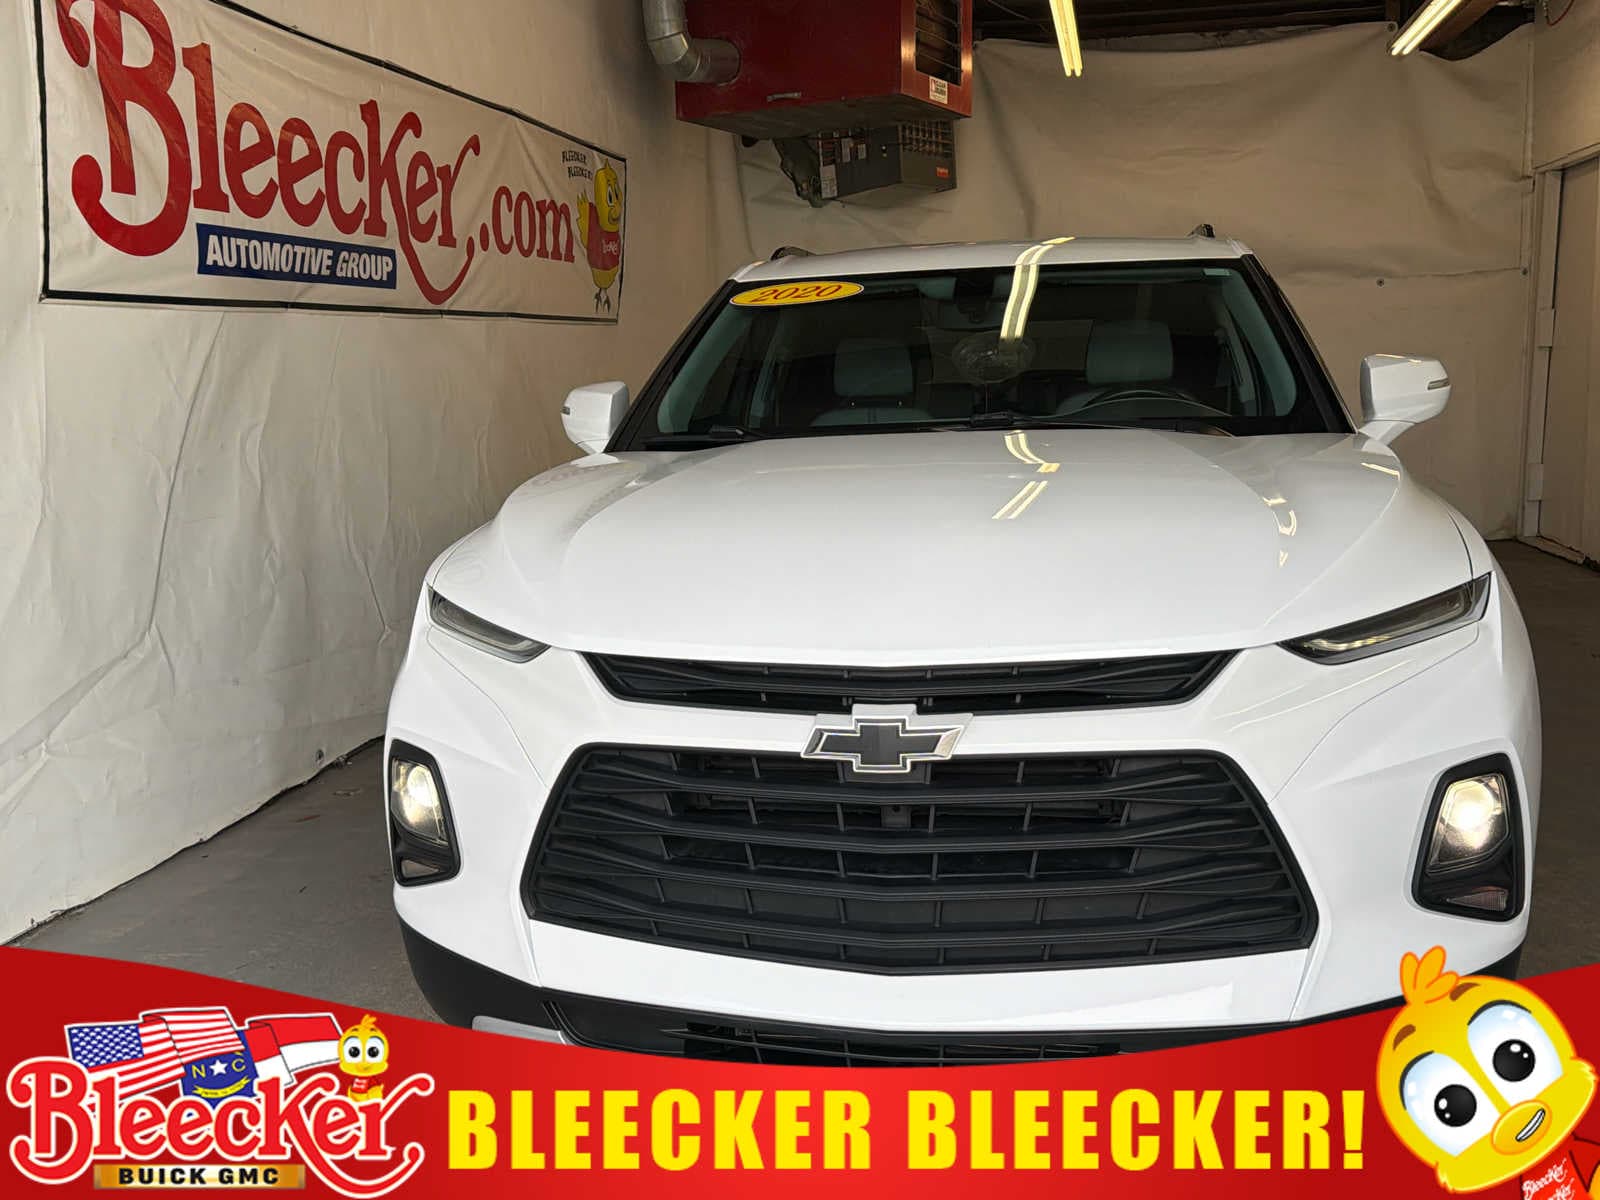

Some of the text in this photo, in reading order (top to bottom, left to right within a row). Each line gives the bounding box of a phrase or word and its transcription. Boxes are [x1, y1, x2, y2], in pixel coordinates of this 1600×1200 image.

[206, 234, 393, 281] AUTOMOTIVE GROUP
[750, 285, 842, 303] 2020
